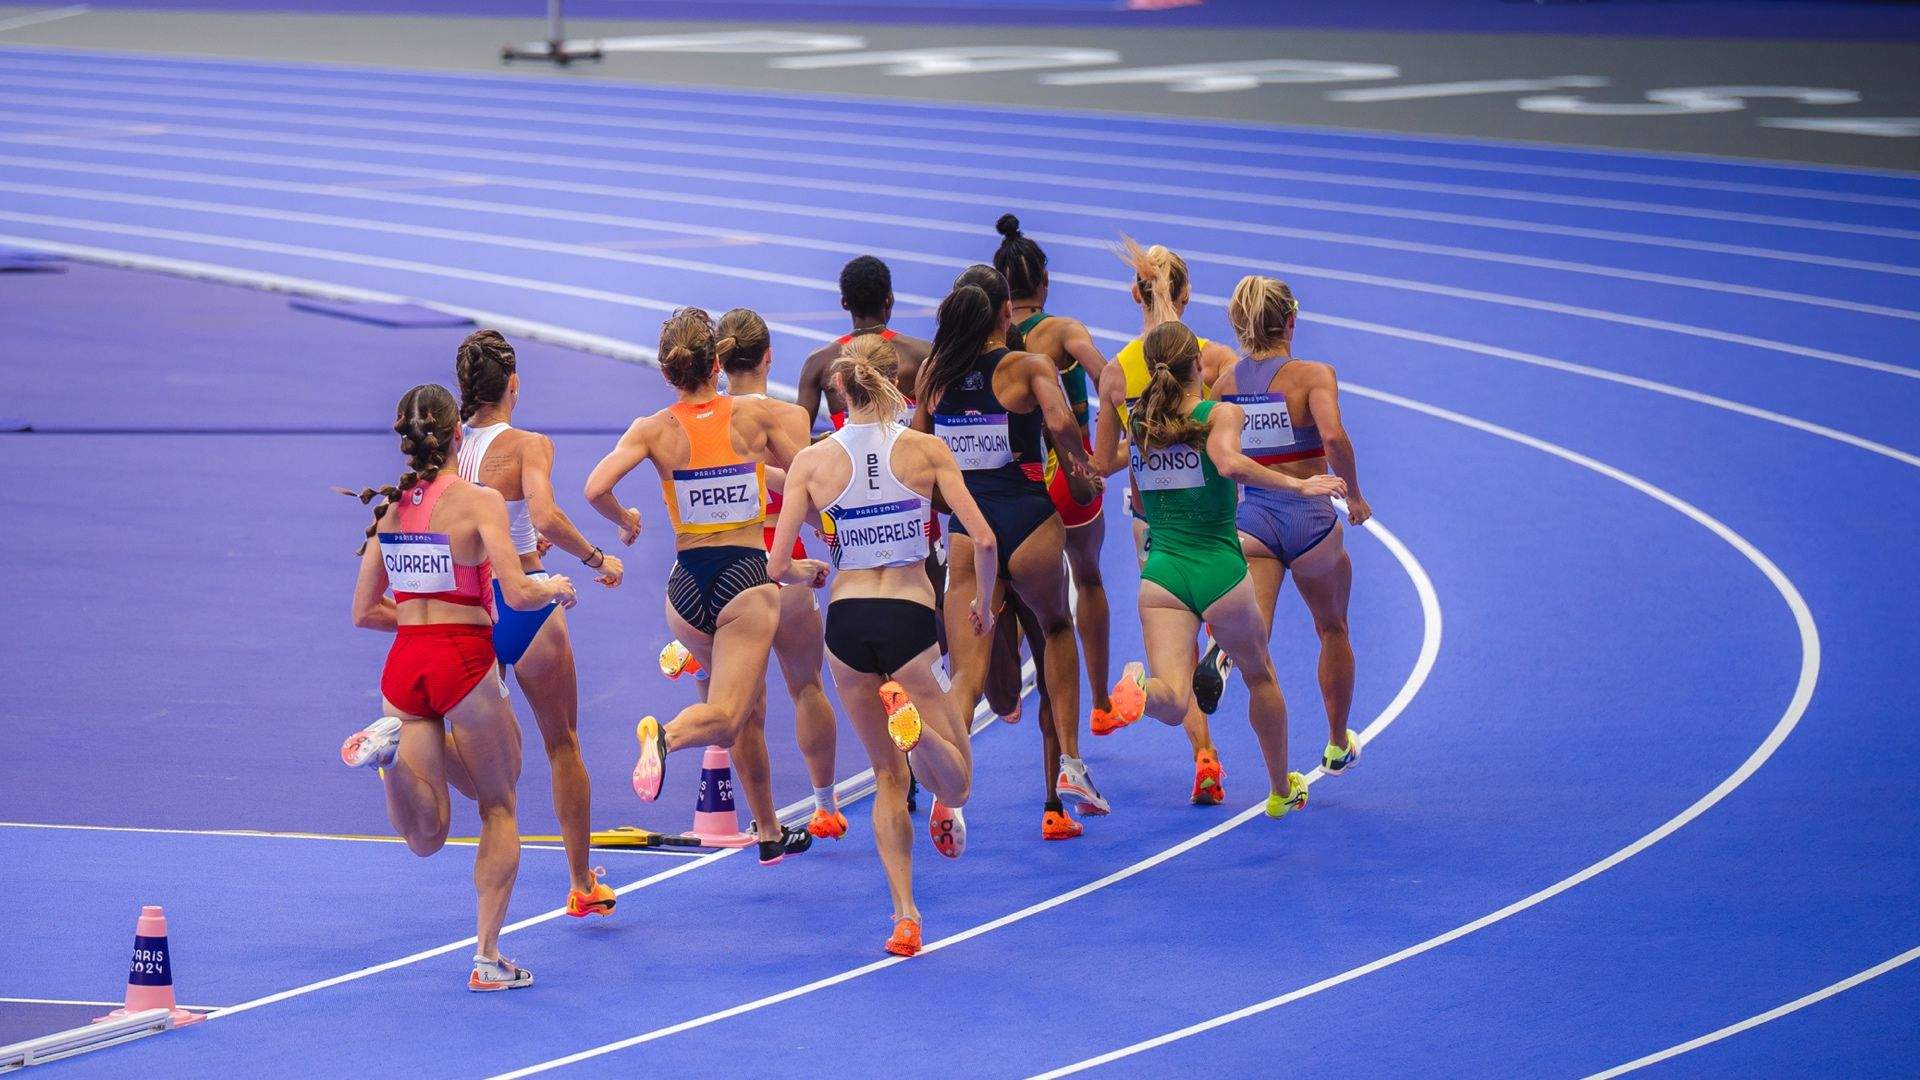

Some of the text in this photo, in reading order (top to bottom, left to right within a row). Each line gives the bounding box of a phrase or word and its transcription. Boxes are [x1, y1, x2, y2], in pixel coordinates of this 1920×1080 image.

[937, 434, 1009, 452] LCOTT-NOLAN
[867, 453, 880, 490] BEL
[689, 484, 749, 507] PEREZ
[385, 554, 450, 574] CURRENT
[130, 961, 163, 974] 2024
